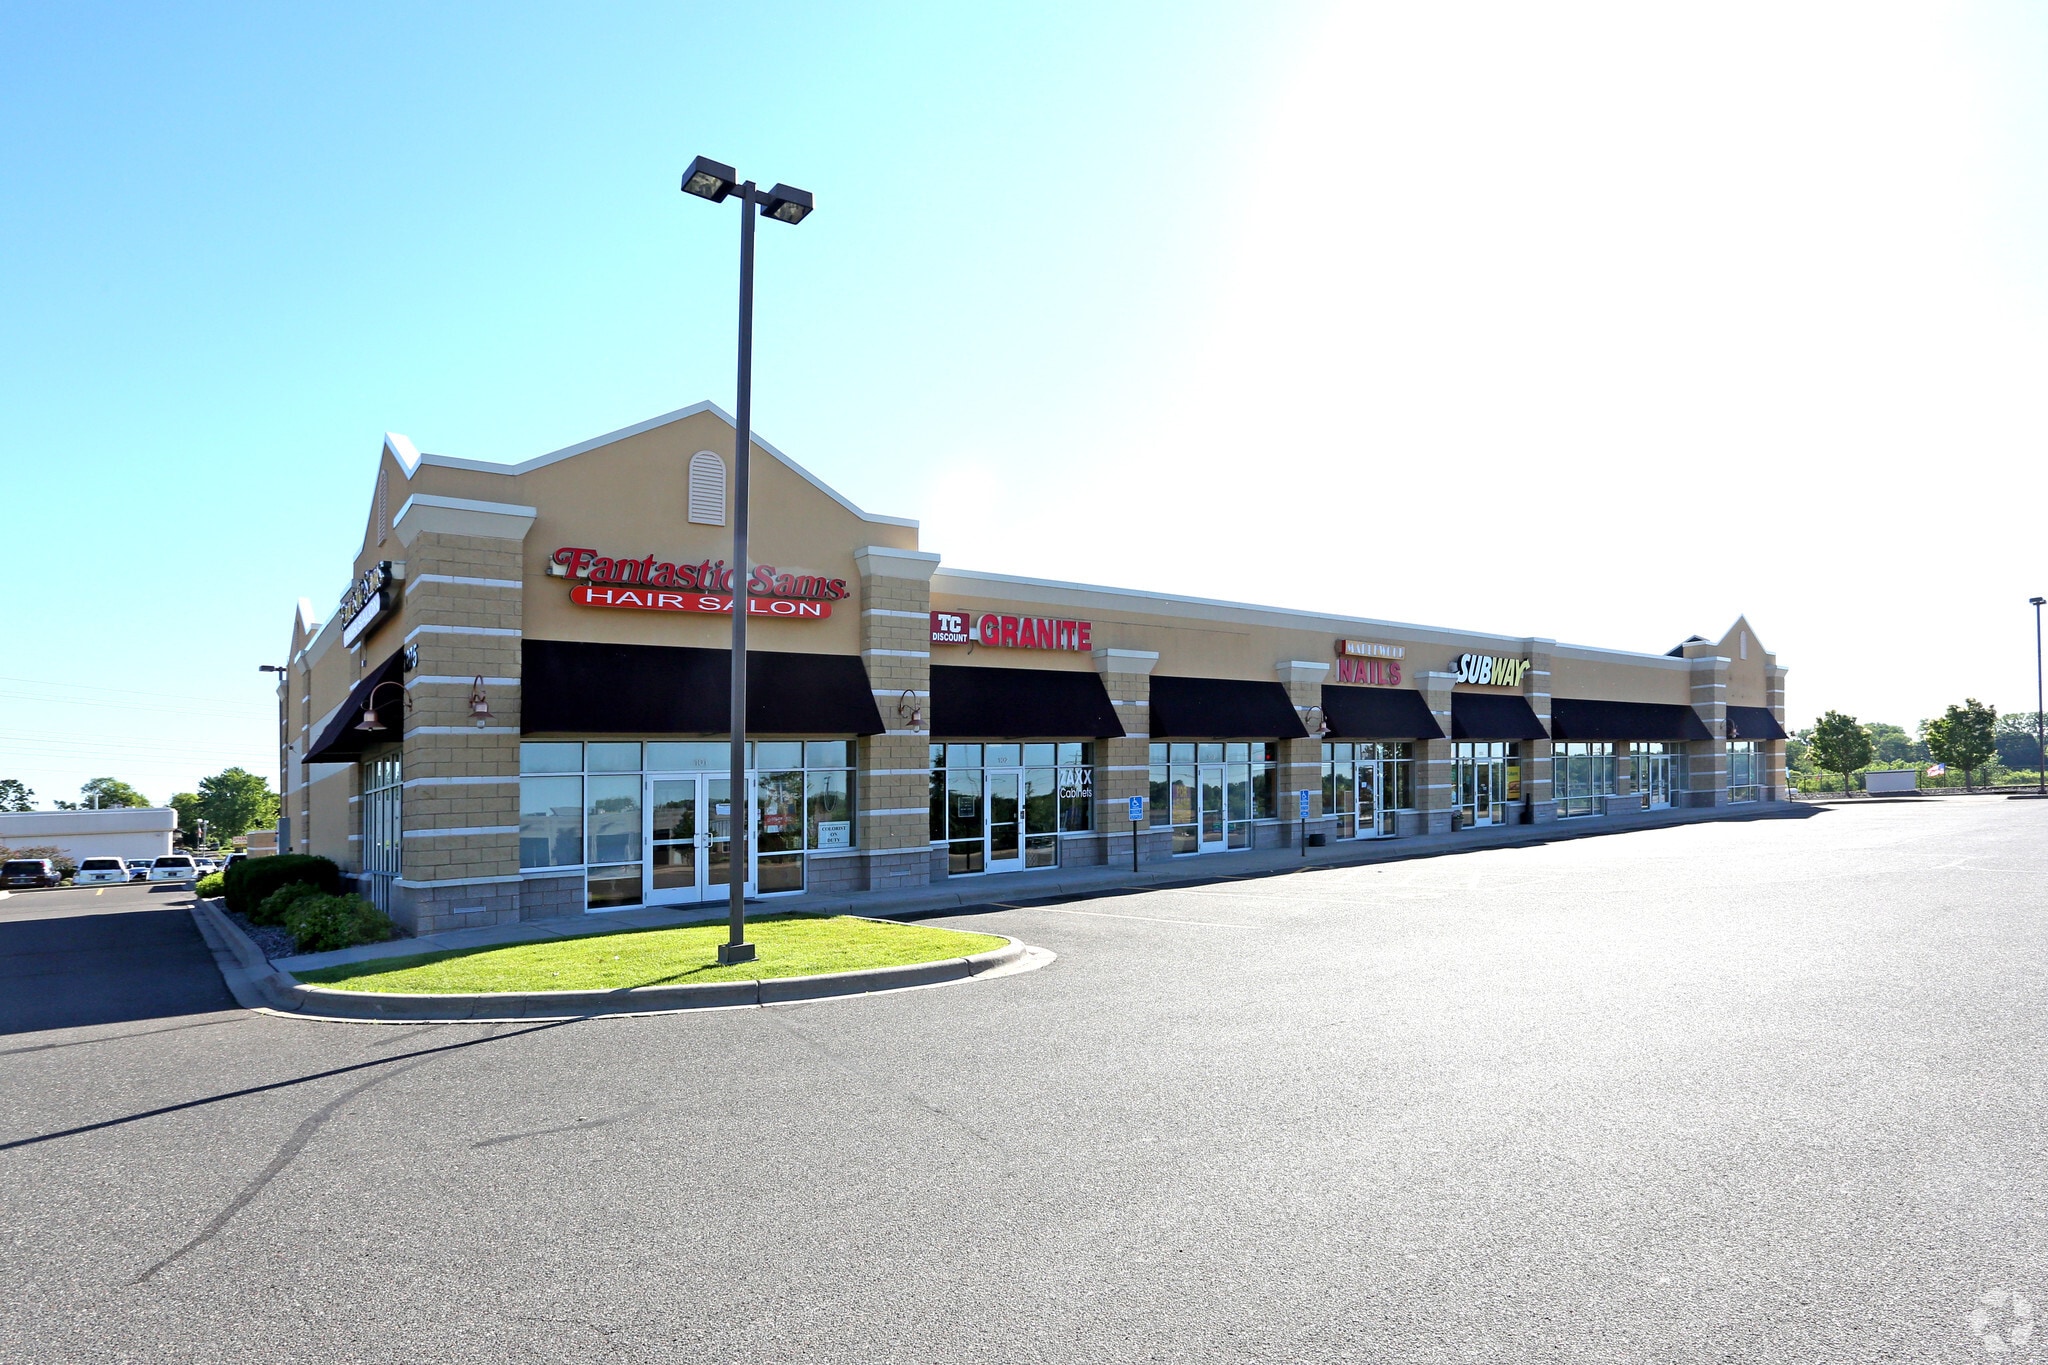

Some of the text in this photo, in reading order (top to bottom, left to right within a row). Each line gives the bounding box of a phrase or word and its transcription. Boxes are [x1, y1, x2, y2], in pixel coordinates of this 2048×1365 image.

[552, 546, 734, 592] Fantastic
[586, 588, 684, 609] HAIR
[938, 613, 962, 634] TC
[978, 613, 1093, 652] GRANITE
[932, 632, 968, 643] DISCOUNT
[1337, 658, 1402, 686] NAILS
[1456, 653, 1531, 687] SUBWAY
[1060, 769, 1092, 785] ZAXX
[1060, 787, 1093, 799] Cabinets
